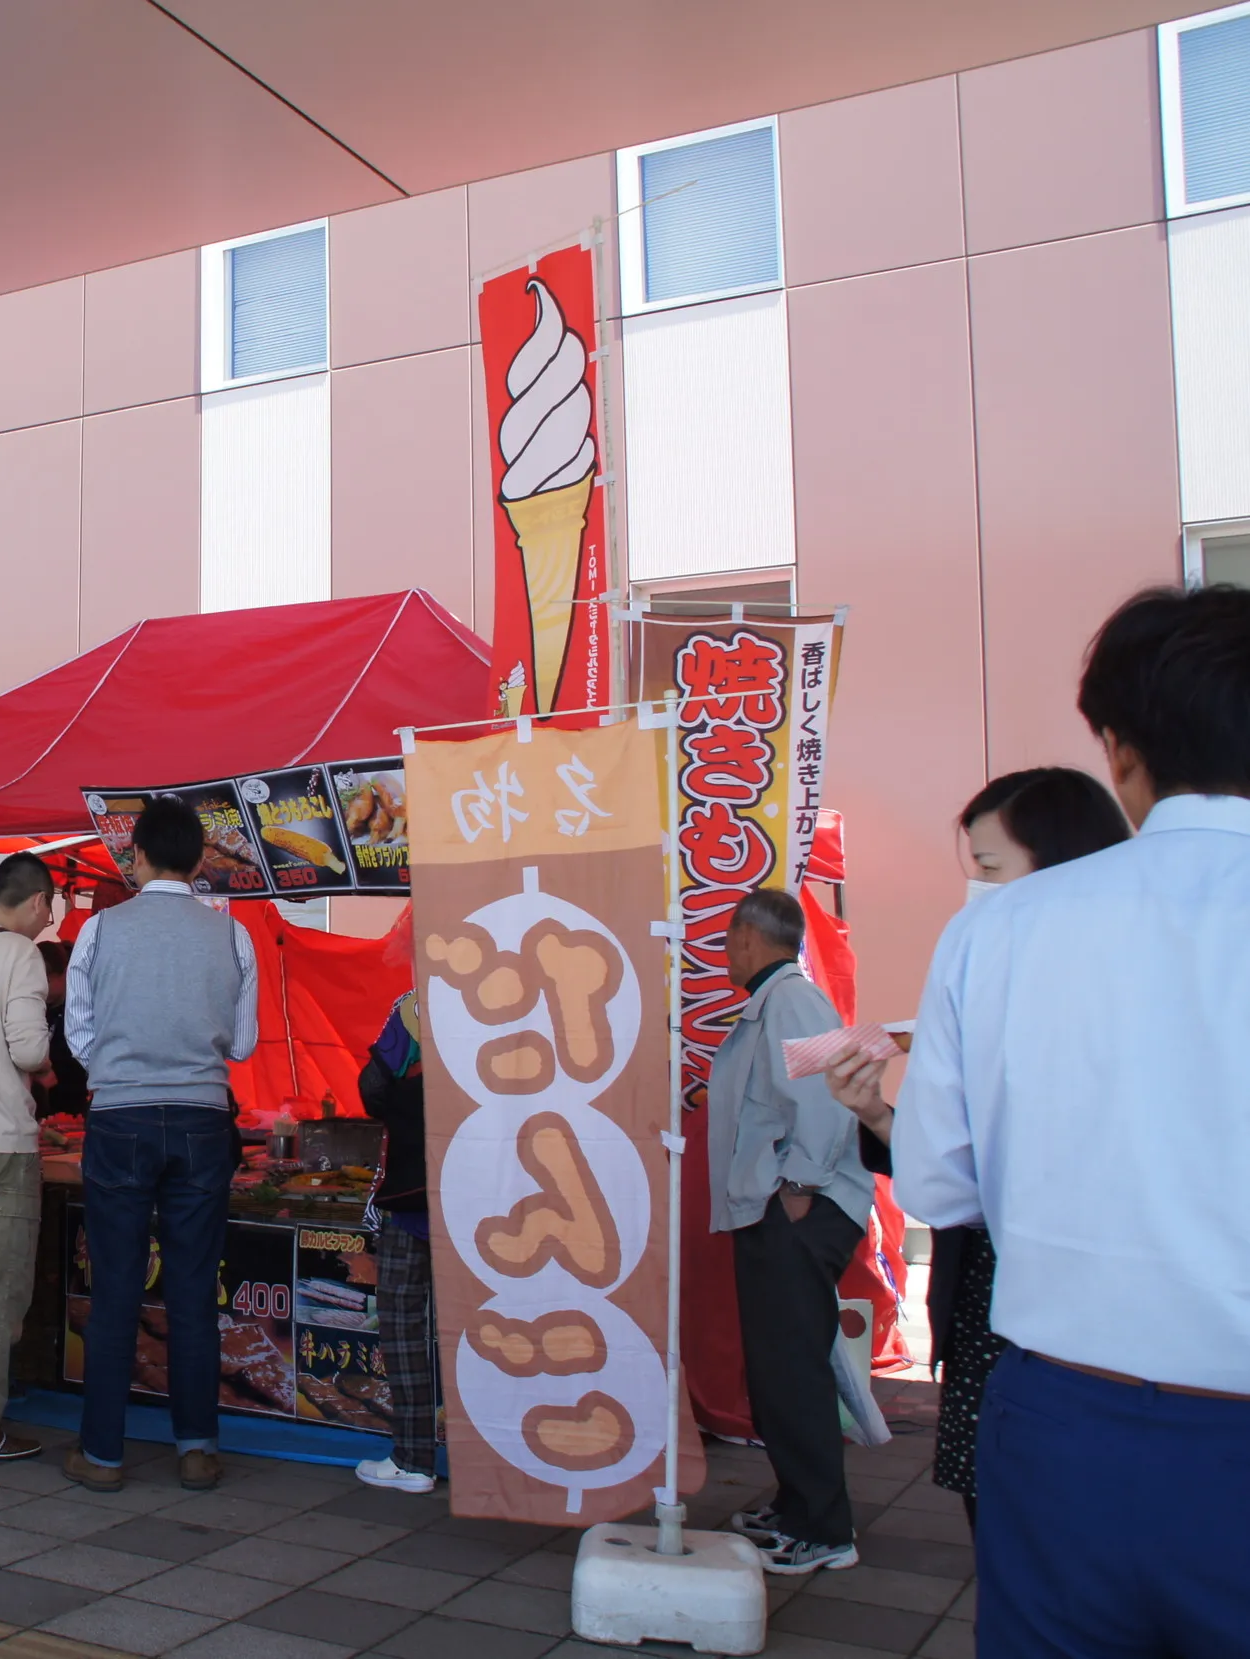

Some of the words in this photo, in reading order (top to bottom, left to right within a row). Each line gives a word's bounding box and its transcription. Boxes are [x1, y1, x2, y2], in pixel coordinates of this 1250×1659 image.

[795, 641, 826, 884] 香ばしく焼き上がった
[199, 808, 244, 832] ラミ焼
[355, 845, 410, 869] 骨付きフランクフ
[228, 871, 265, 890] 400
[233, 1280, 290, 1319] 400
